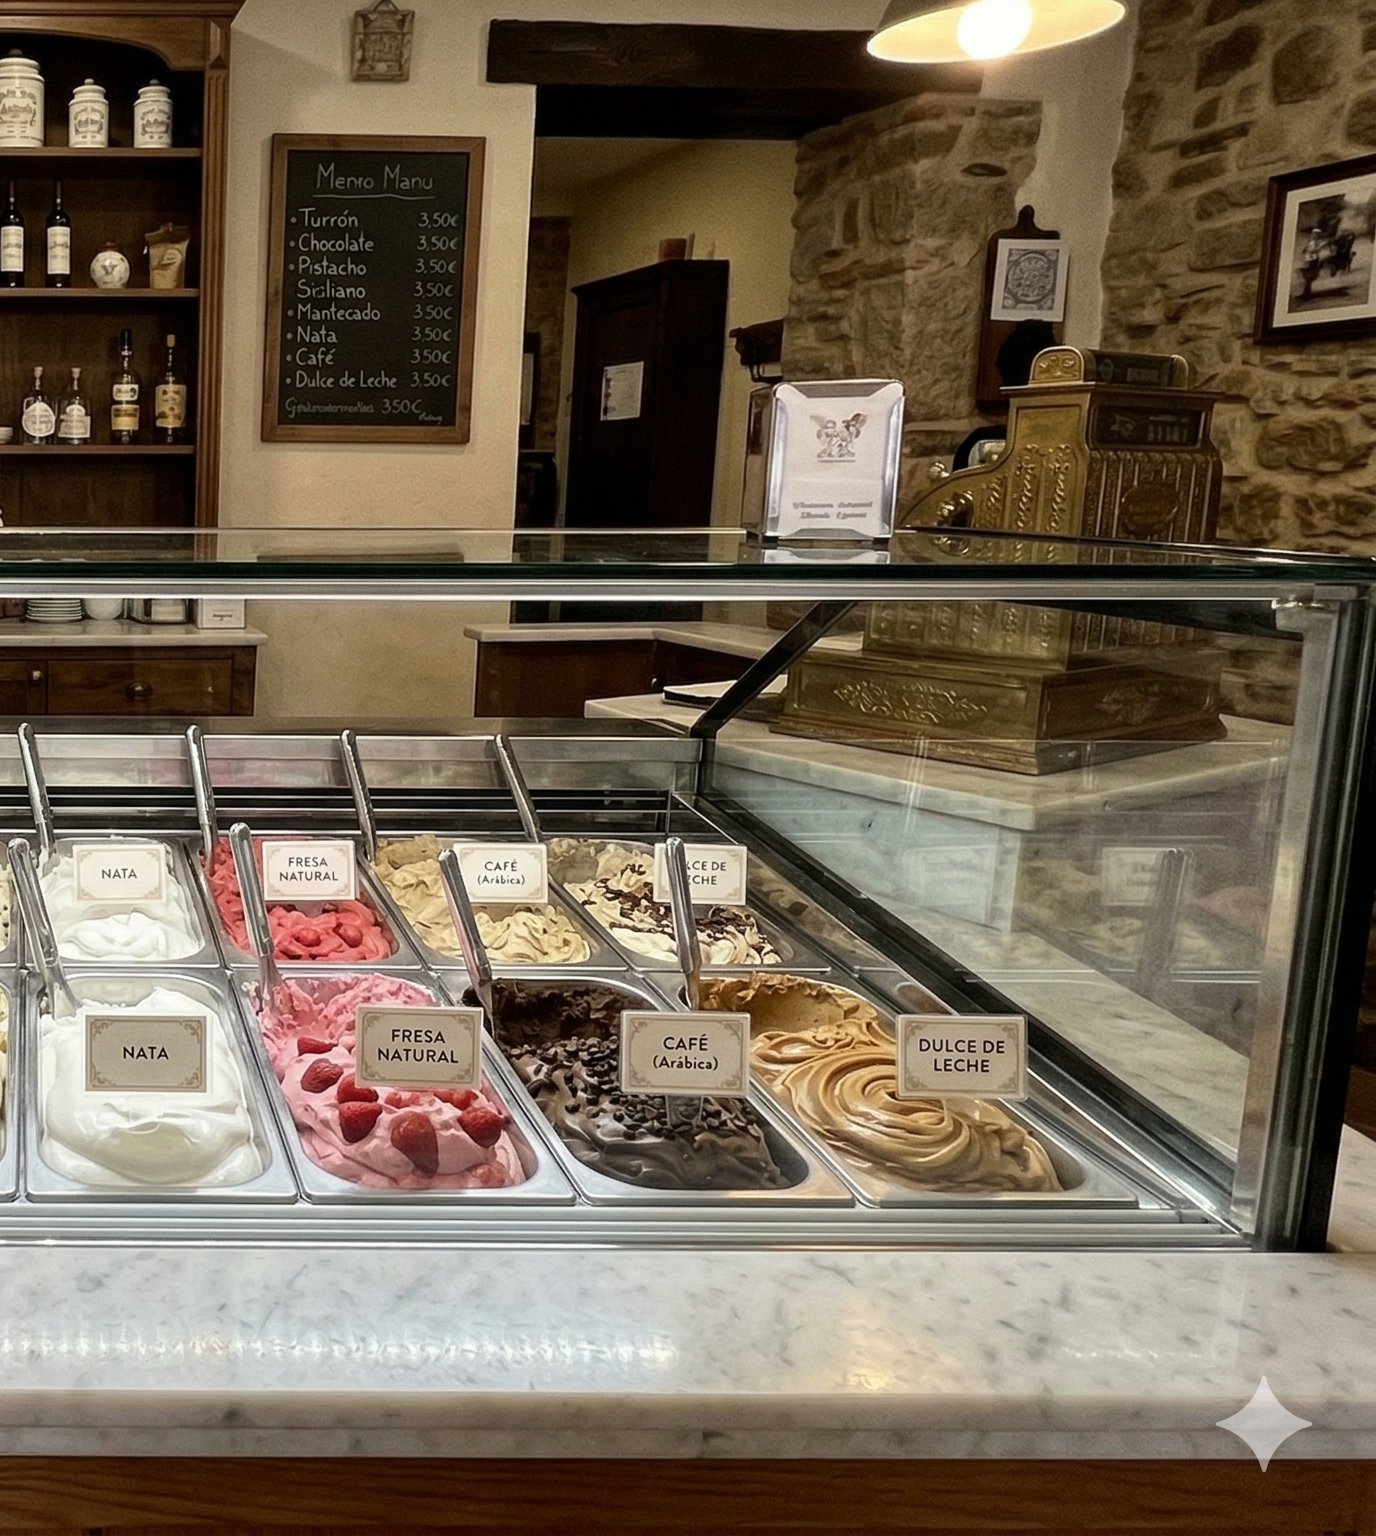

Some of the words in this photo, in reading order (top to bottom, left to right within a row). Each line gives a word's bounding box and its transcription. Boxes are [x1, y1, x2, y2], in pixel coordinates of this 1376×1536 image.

[383, 163, 433, 190] Manu
[298, 207, 359, 228] Turrón
[298, 231, 374, 252] Chocolate
[298, 255, 367, 276] Pistacho
[297, 301, 381, 321] Mantecado
[297, 324, 338, 343] Nata
[295, 346, 336, 368] Café
[295, 370, 335, 388] Dulce
[339, 370, 356, 388] de
[359, 369, 397, 388] Leche
[288, 856, 329, 868] FRESA
[484, 859, 518, 872] CAFÉ
[711, 861, 727, 872] DE
[101, 868, 138, 879] NATA
[279, 871, 339, 882] NATURAL
[477, 874, 526, 886] (Arábica)
[688, 874, 717, 886] CHE
[391, 1028, 446, 1044] FRESA
[663, 1033, 708, 1052] CAFÉ
[123, 1046, 169, 1060] NATA
[919, 1038, 977, 1054] DULCE
[982, 1040, 1005, 1054] DE
[377, 1047, 459, 1064] NATURAL
[652, 1054, 719, 1071] (Arábica)
[933, 1058, 990, 1073] LECHE
